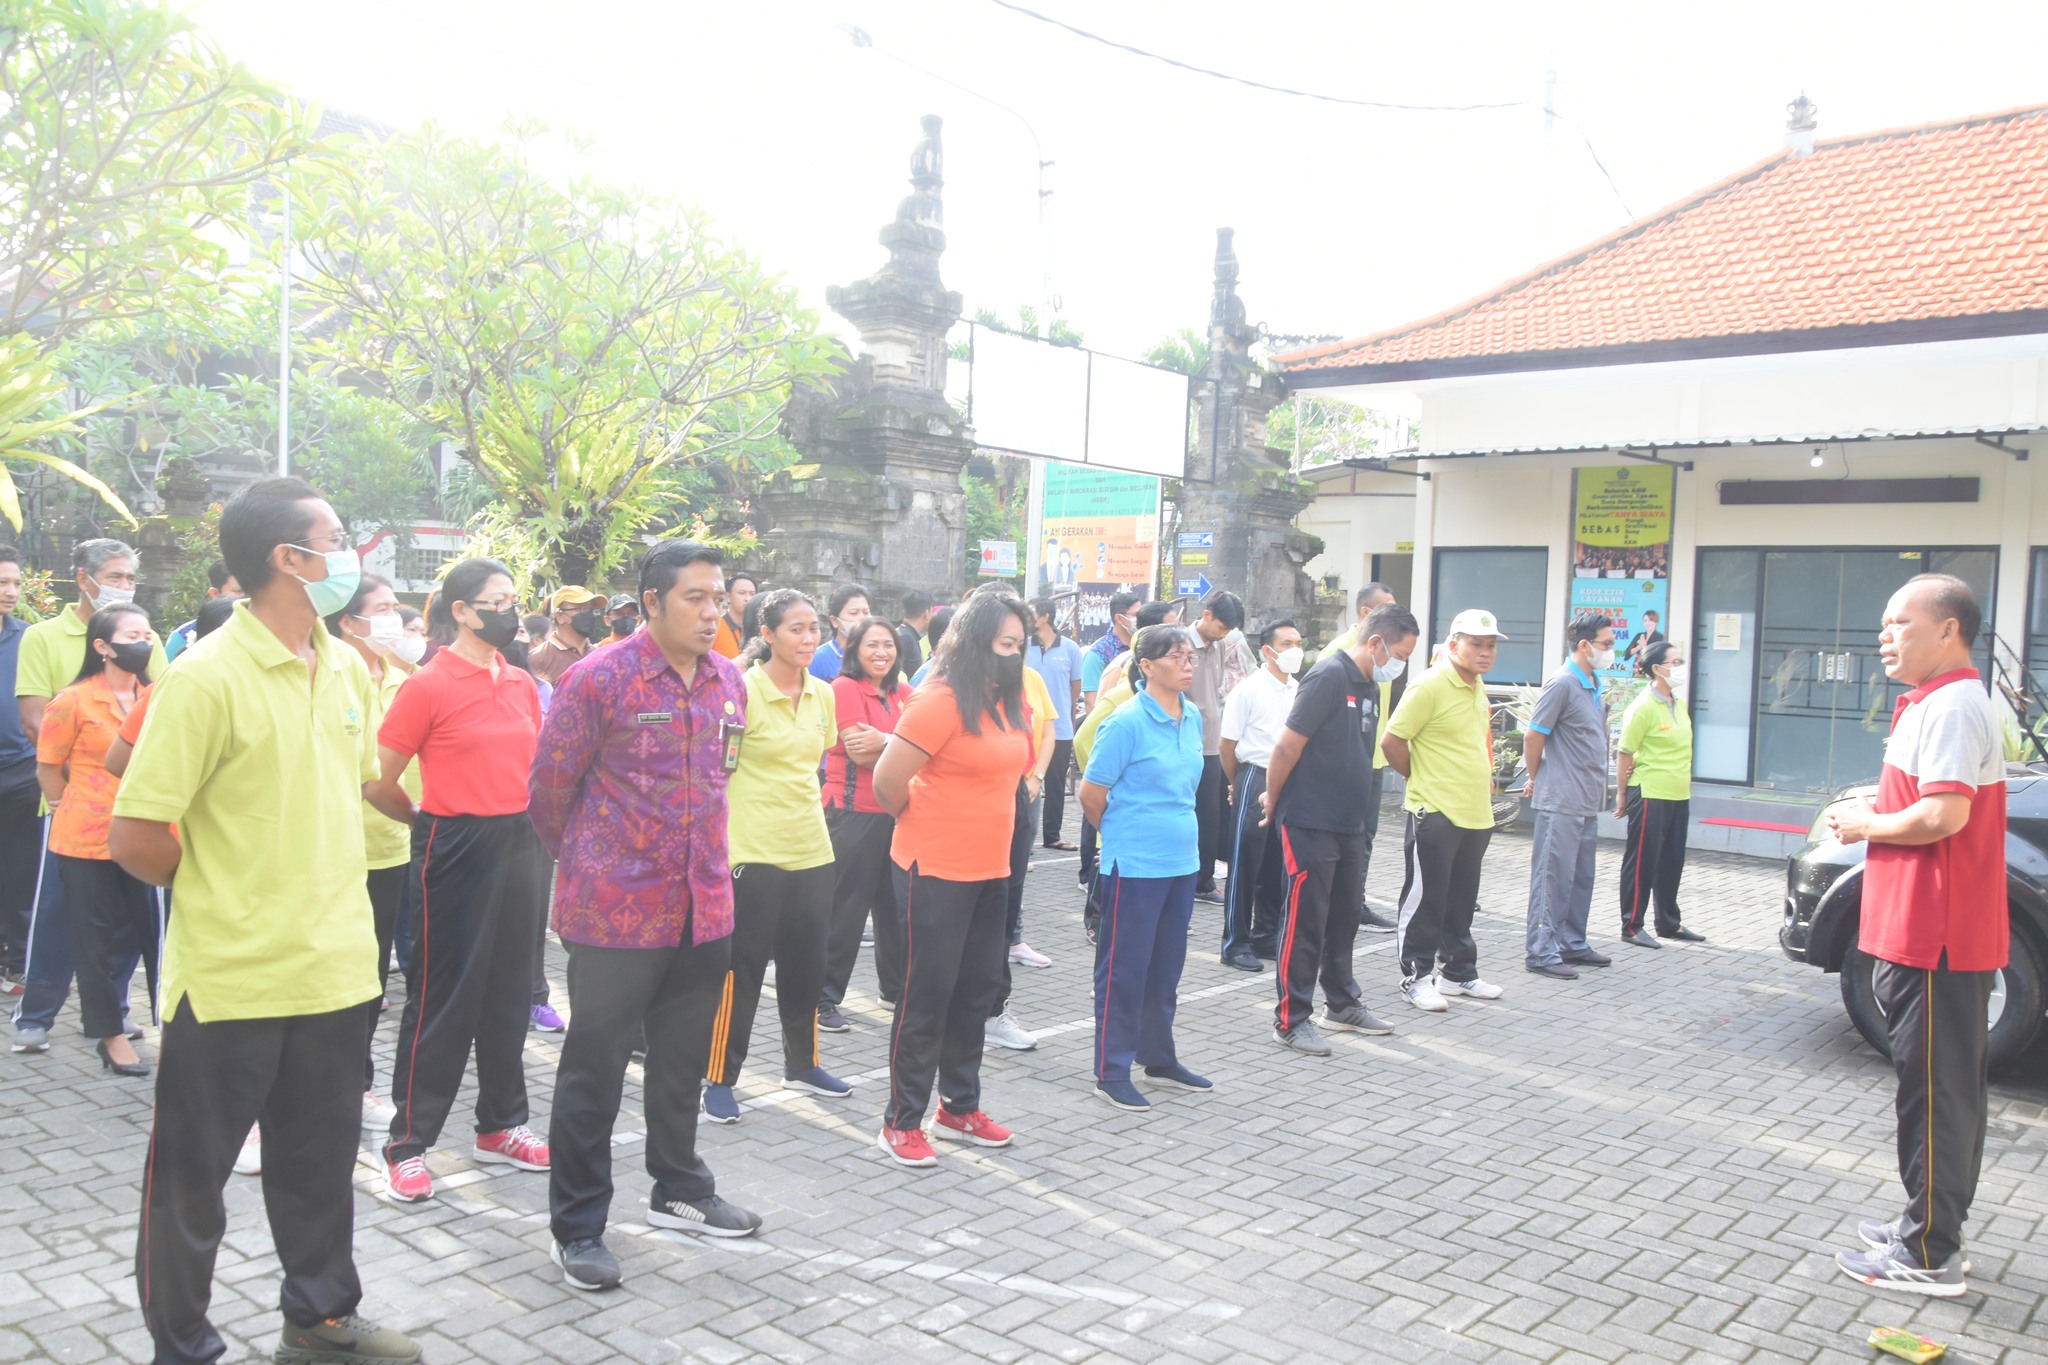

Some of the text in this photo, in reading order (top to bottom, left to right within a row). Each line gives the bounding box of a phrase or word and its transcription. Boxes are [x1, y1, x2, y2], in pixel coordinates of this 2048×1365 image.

[1062, 527, 1093, 536] GERAKAN
[1582, 525, 1620, 534] BEBAS
[1582, 595, 1623, 603] LAYANAN
